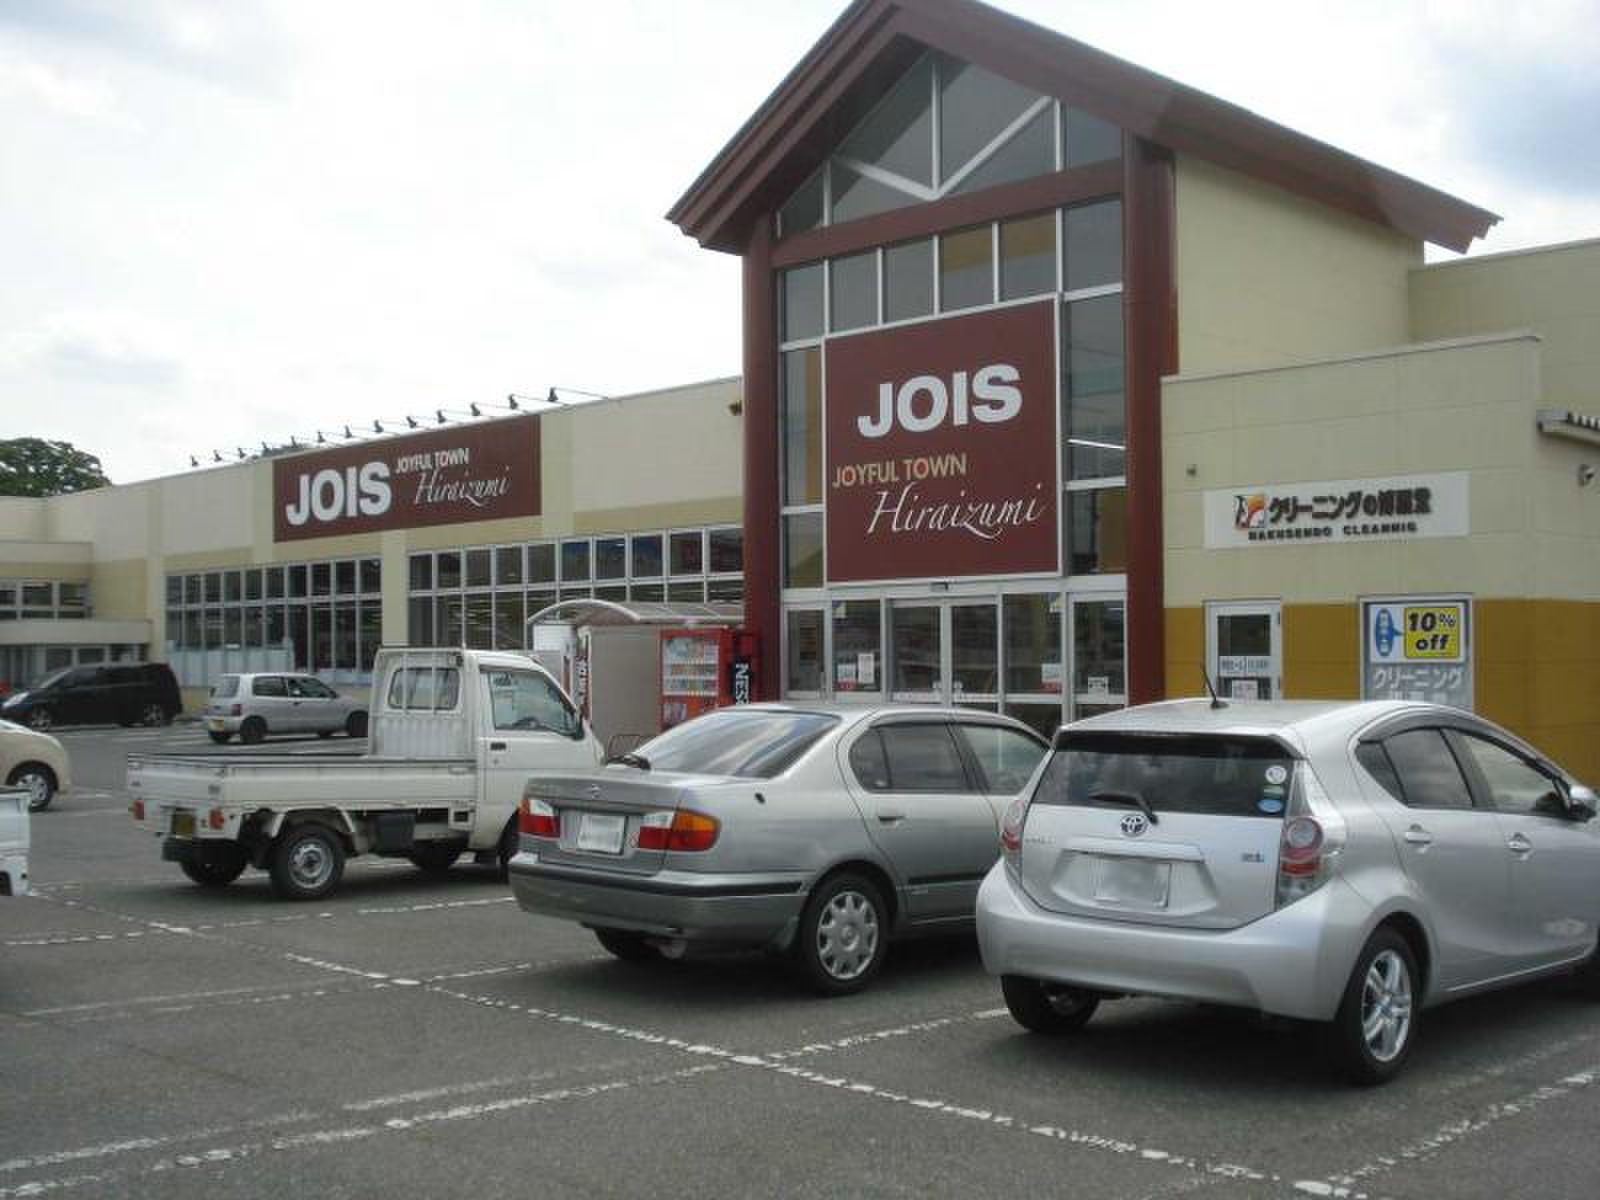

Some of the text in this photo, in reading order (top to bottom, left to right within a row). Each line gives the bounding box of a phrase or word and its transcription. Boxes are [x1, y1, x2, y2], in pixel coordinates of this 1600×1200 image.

[857, 363, 1022, 438] JOIS
[395, 447, 469, 474] JOYFUL TOWN
[832, 453, 967, 488] JOYFUL TOWN
[286, 461, 392, 526] JOIS
[414, 465, 510, 507] Hiraizumi
[866, 482, 1044, 540] Hiraizumi
[1407, 611, 1456, 632] 10%
[1415, 634, 1450, 651] off
